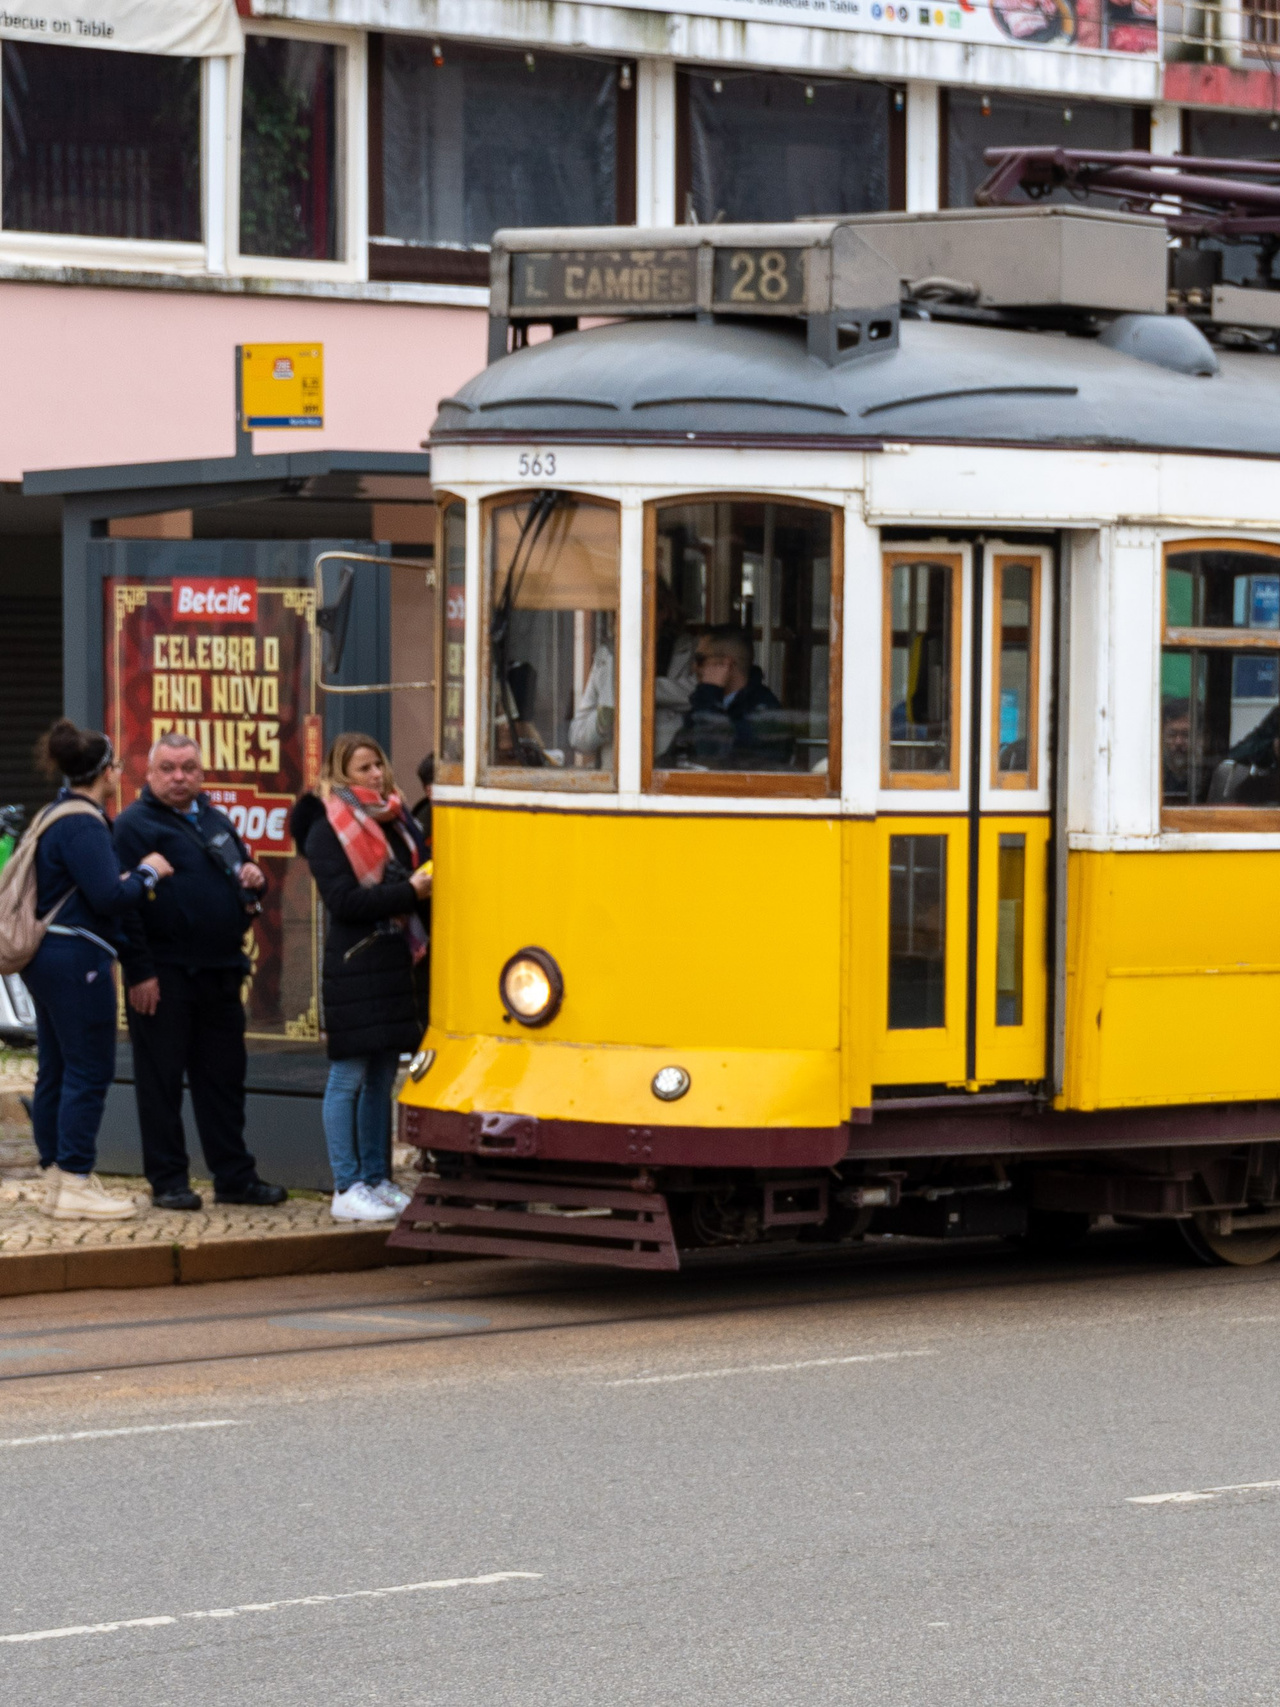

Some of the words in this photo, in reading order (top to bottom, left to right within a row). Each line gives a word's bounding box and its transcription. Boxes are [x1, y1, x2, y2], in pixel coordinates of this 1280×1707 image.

[52, 20, 71, 34] on
[75, 18, 115, 39] Table
[730, 250, 790, 302] 28
[518, 452, 556, 477] 563
[177, 585, 252, 615] Betclic
[153, 634, 257, 674] CELEBRA
[263, 636, 280, 672] O
[152, 673, 203, 712] ANO
[211, 675, 280, 715] NOVO
